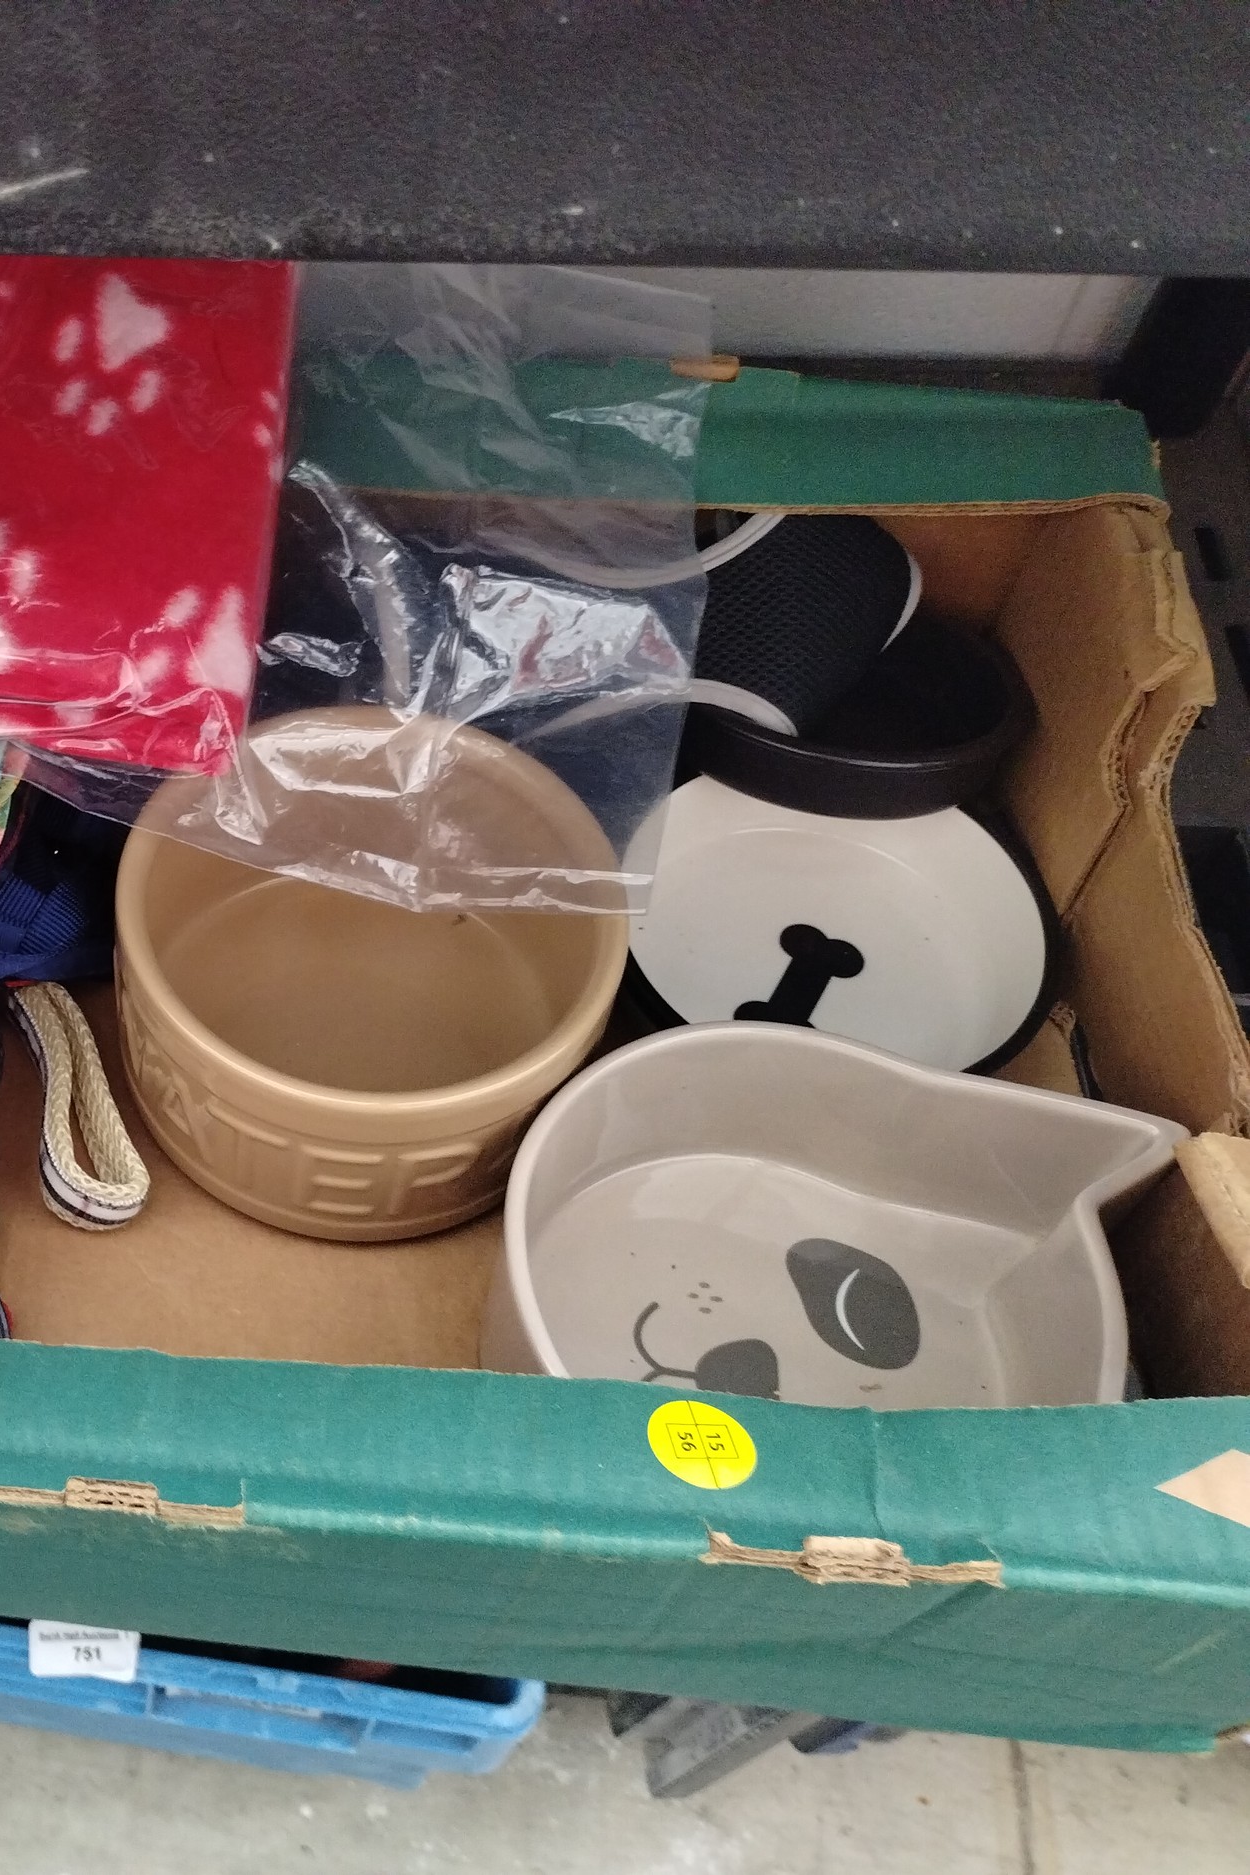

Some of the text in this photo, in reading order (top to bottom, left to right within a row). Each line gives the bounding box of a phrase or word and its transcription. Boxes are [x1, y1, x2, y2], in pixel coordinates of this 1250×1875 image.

[677, 1431, 697, 1452] 56
[706, 1433, 726, 1451] 15
[72, 1645, 103, 1663] 751
